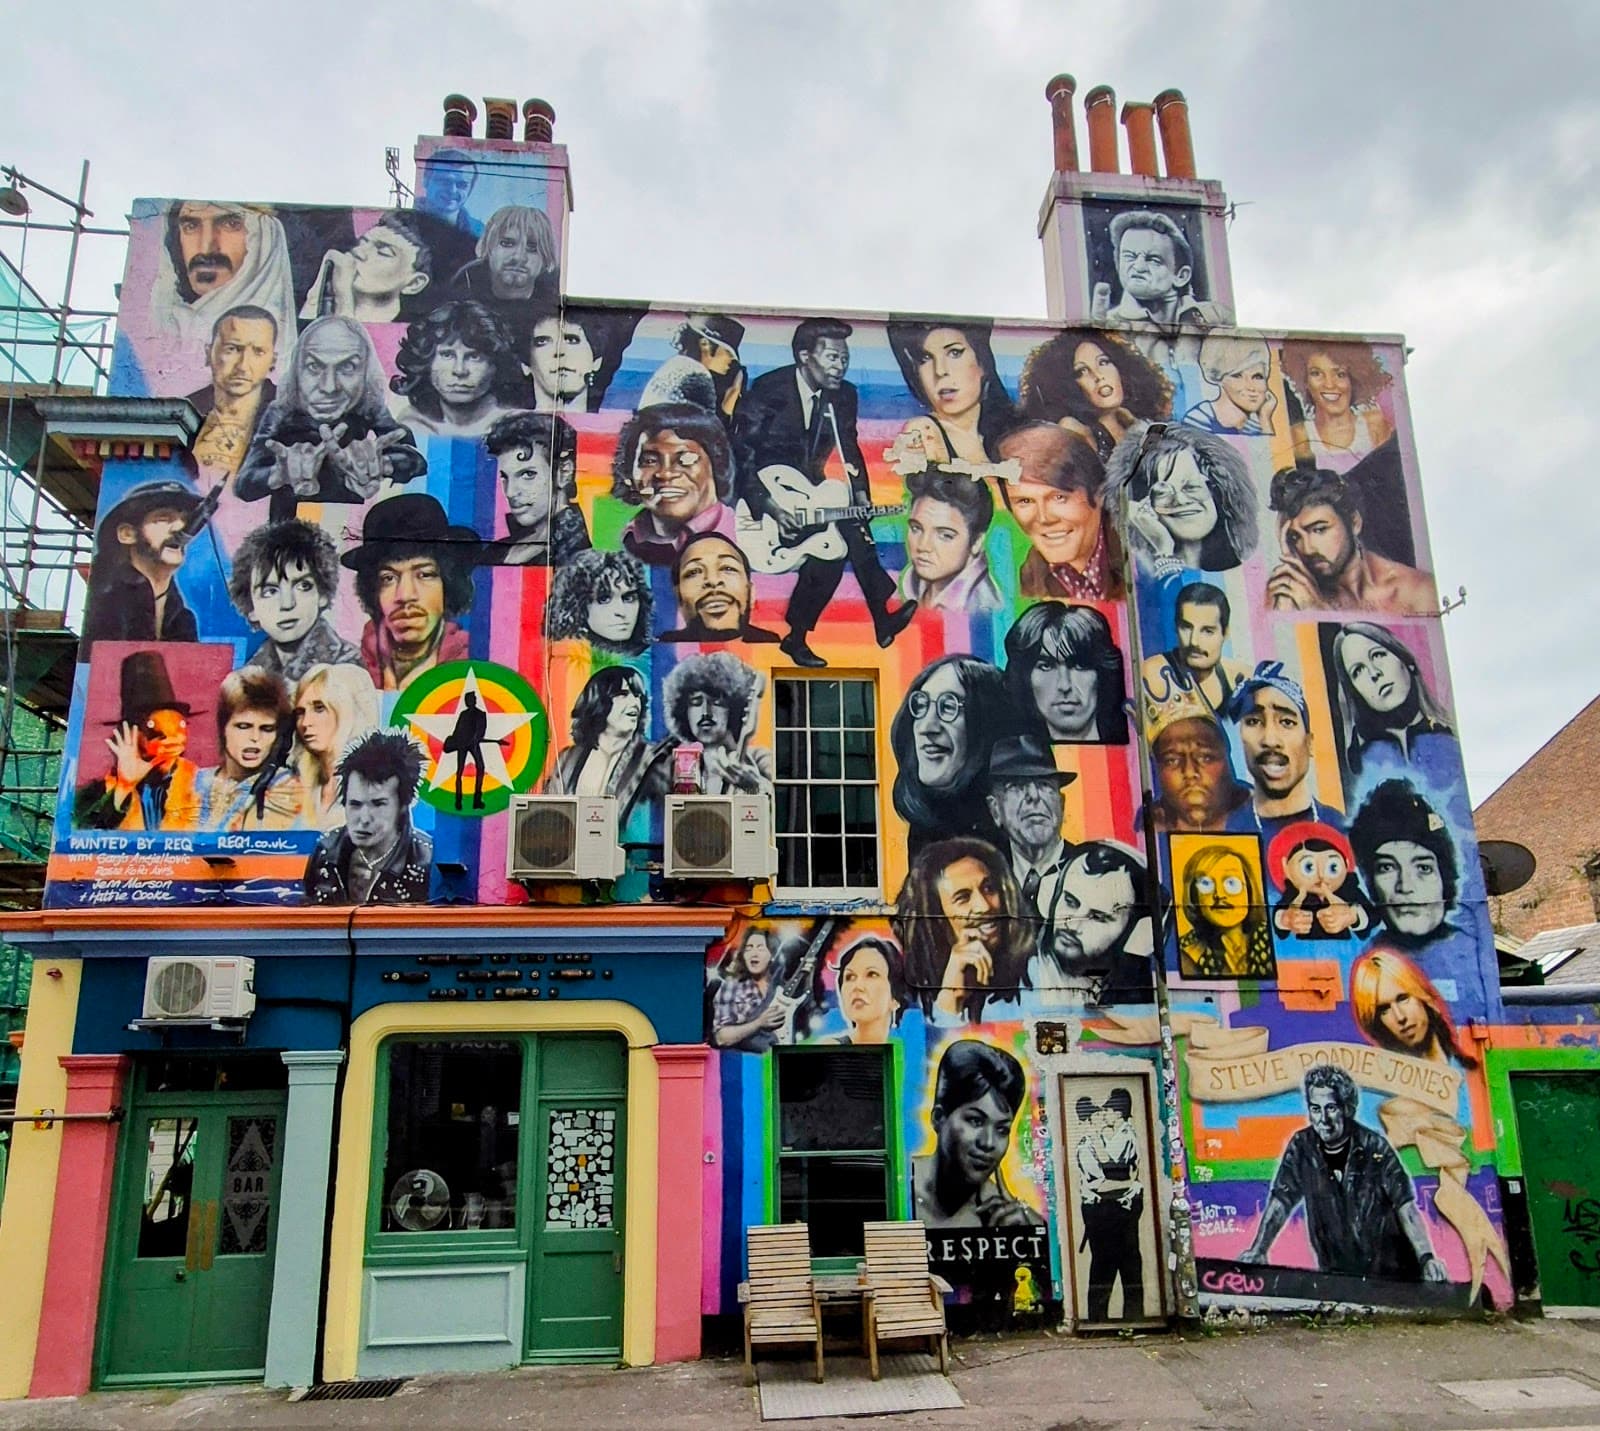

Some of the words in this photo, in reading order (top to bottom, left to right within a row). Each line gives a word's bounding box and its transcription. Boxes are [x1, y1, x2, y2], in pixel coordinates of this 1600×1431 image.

[70, 837, 128, 850] PAINTED
[136, 837, 156, 850] BY
[164, 838, 194, 852] REQ
[1210, 1058, 1289, 1090] STEVE
[1385, 1058, 1454, 1100] JONES
[233, 1176, 264, 1193] BAR
[1223, 1205, 1237, 1217] TO
